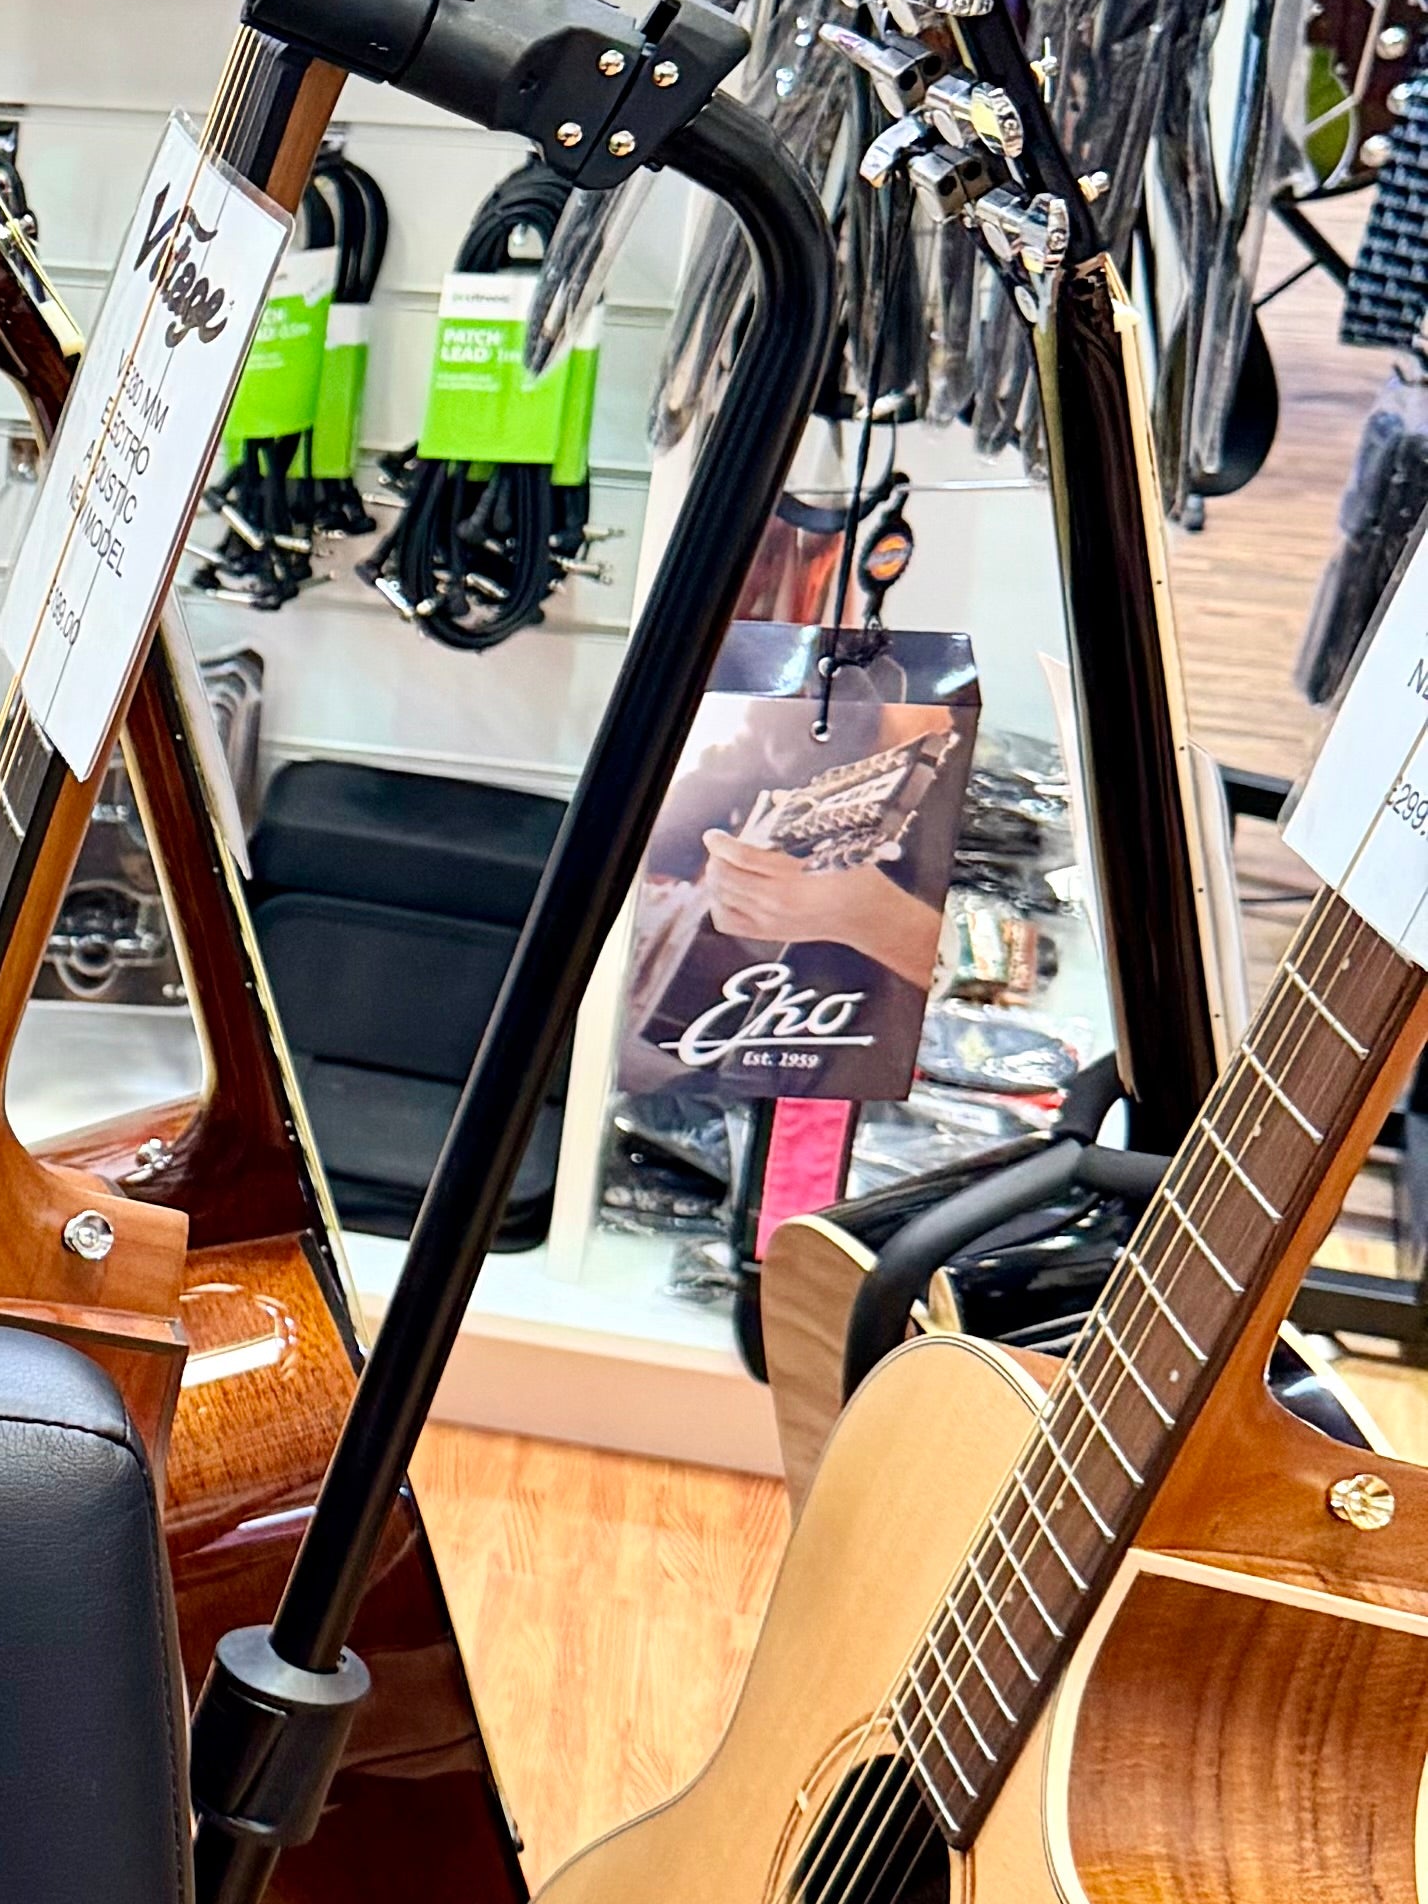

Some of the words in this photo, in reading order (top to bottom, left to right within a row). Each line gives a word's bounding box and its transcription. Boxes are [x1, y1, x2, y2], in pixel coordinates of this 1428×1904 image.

[441, 345, 489, 363] LEAD
[444, 327, 502, 346] PATCH
[101, 395, 150, 476] EECTRO
[82, 438, 139, 525] AOUSTIC
[84, 506, 126, 579] MODEL
[658, 961, 875, 1067] Eko
[742, 1050, 774, 1066] Est.
[777, 1051, 820, 1069] 1959
